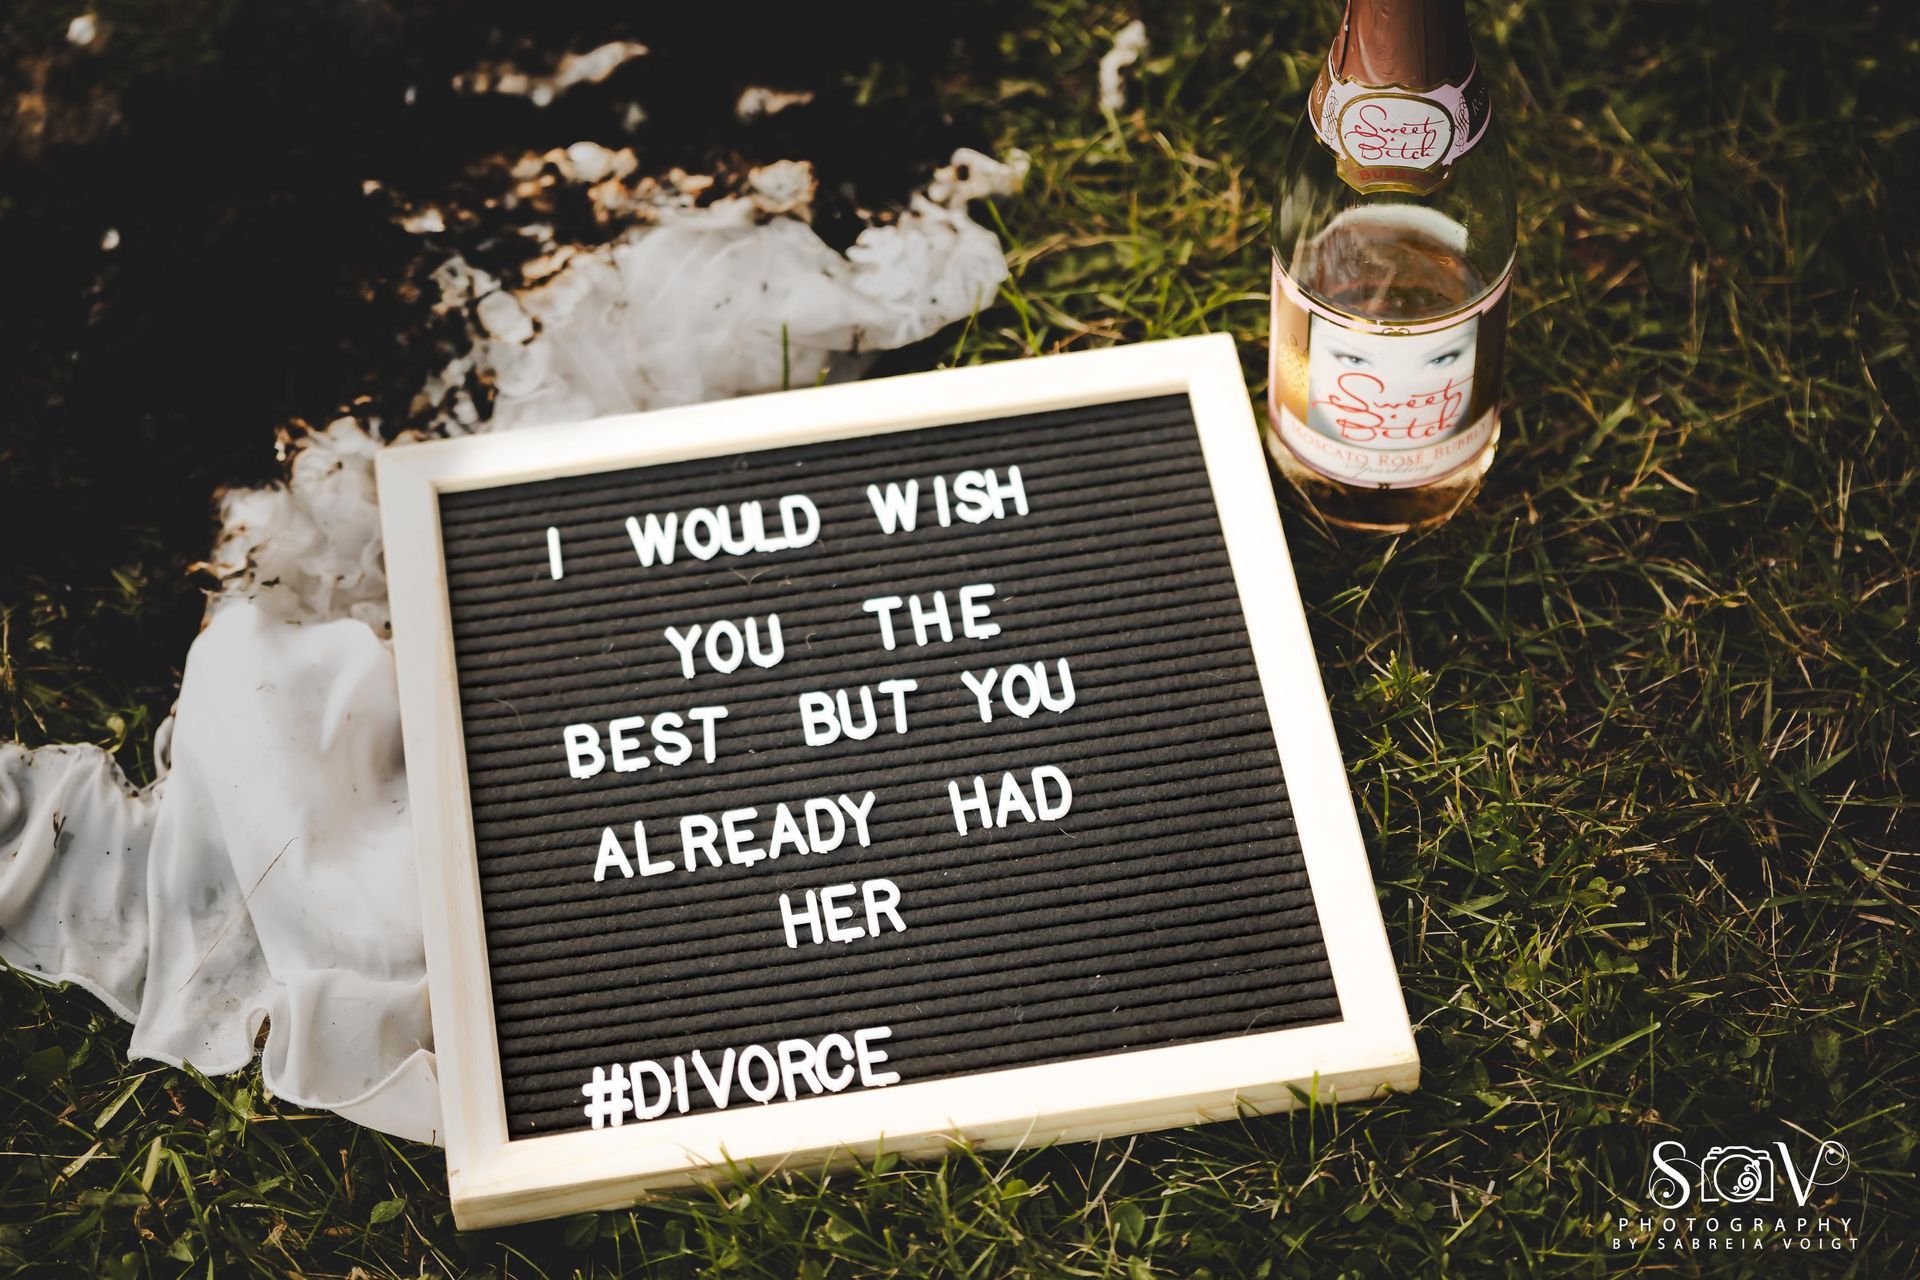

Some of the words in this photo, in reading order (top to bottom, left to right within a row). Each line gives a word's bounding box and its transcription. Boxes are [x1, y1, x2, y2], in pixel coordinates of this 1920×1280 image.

[1345, 129, 1437, 160] Bitch
[1354, 104, 1444, 136] Sweet
[1312, 392, 1461, 442] Bitch
[1329, 373, 1474, 412] Sweet
[547, 527, 563, 581] I
[625, 495, 821, 567] WOULD
[866, 465, 1029, 535] WISH
[664, 613, 785, 680] YOU
[862, 583, 1001, 651] THE
[563, 705, 729, 780] BEST
[798, 679, 918, 747] BUT
[960, 657, 1076, 724] YOU
[593, 790, 876, 882] ALREADY
[947, 765, 1073, 836] HAD
[778, 878, 907, 949] HER
[580, 1026, 901, 1130] #DIVORCE
